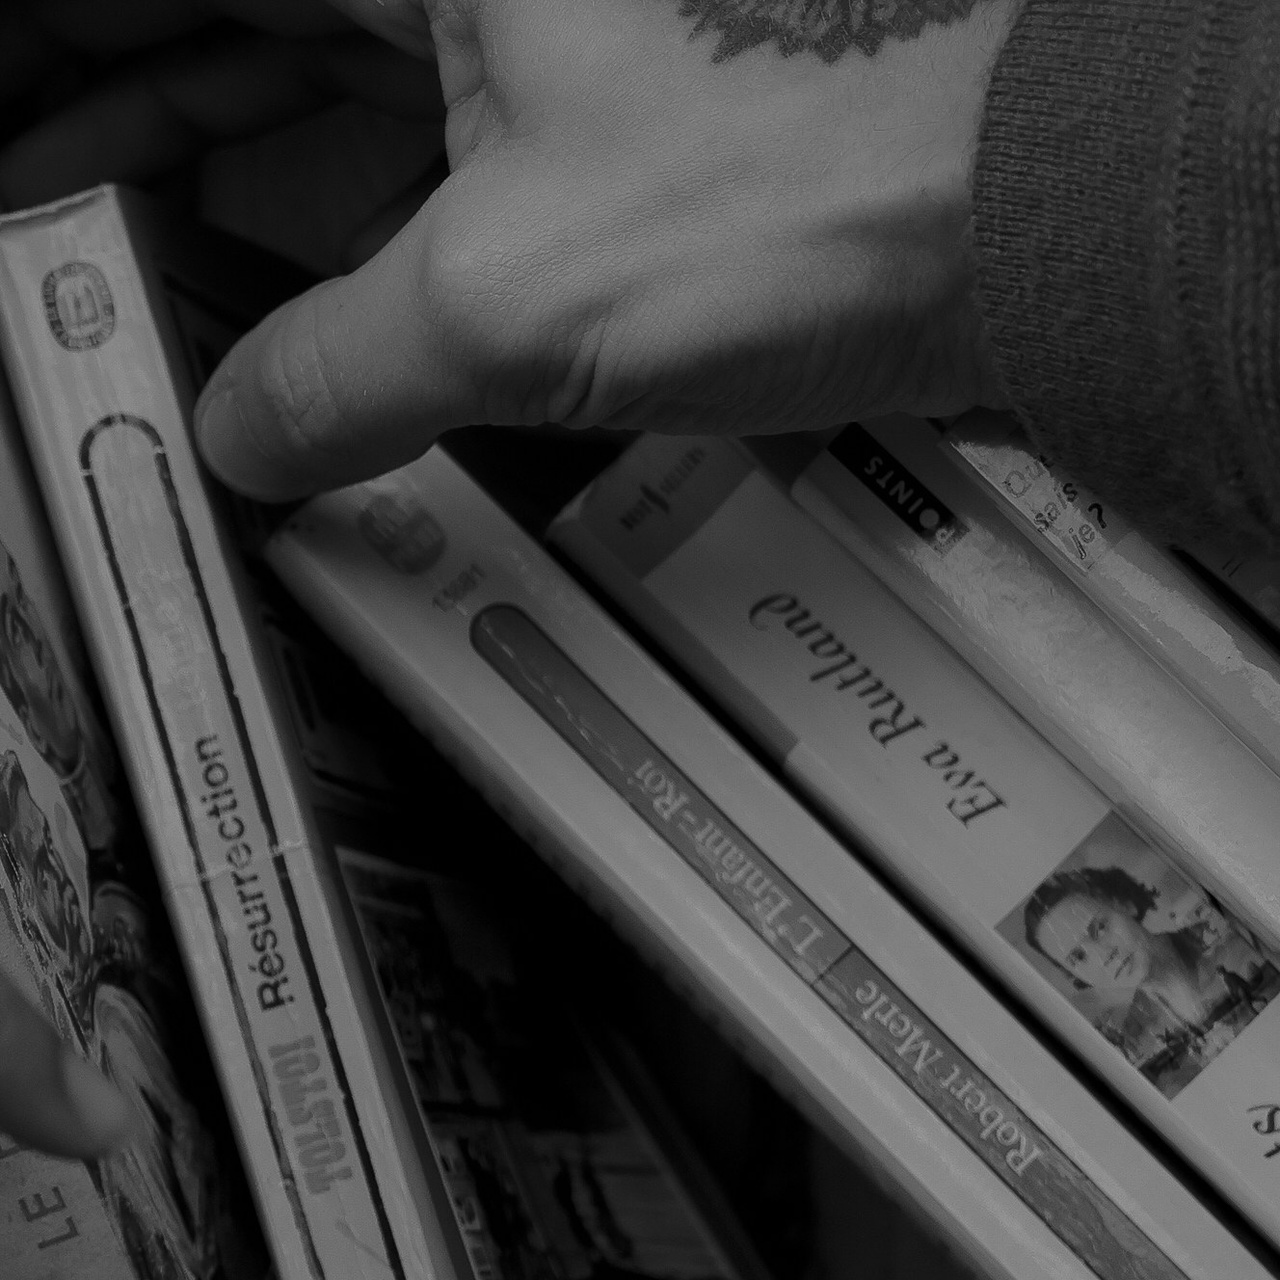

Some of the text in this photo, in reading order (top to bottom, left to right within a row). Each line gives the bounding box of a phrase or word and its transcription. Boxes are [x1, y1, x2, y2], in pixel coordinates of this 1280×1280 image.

[863, 454, 959, 556] POINTS
[1032, 481, 1080, 533] sais
[748, 592, 1008, 829] Eva Rutland
[195, 734, 295, 1012] Résurrection
[854, 978, 1044, 1175] Robert Merle
[18, 1186, 80, 1250] LE
